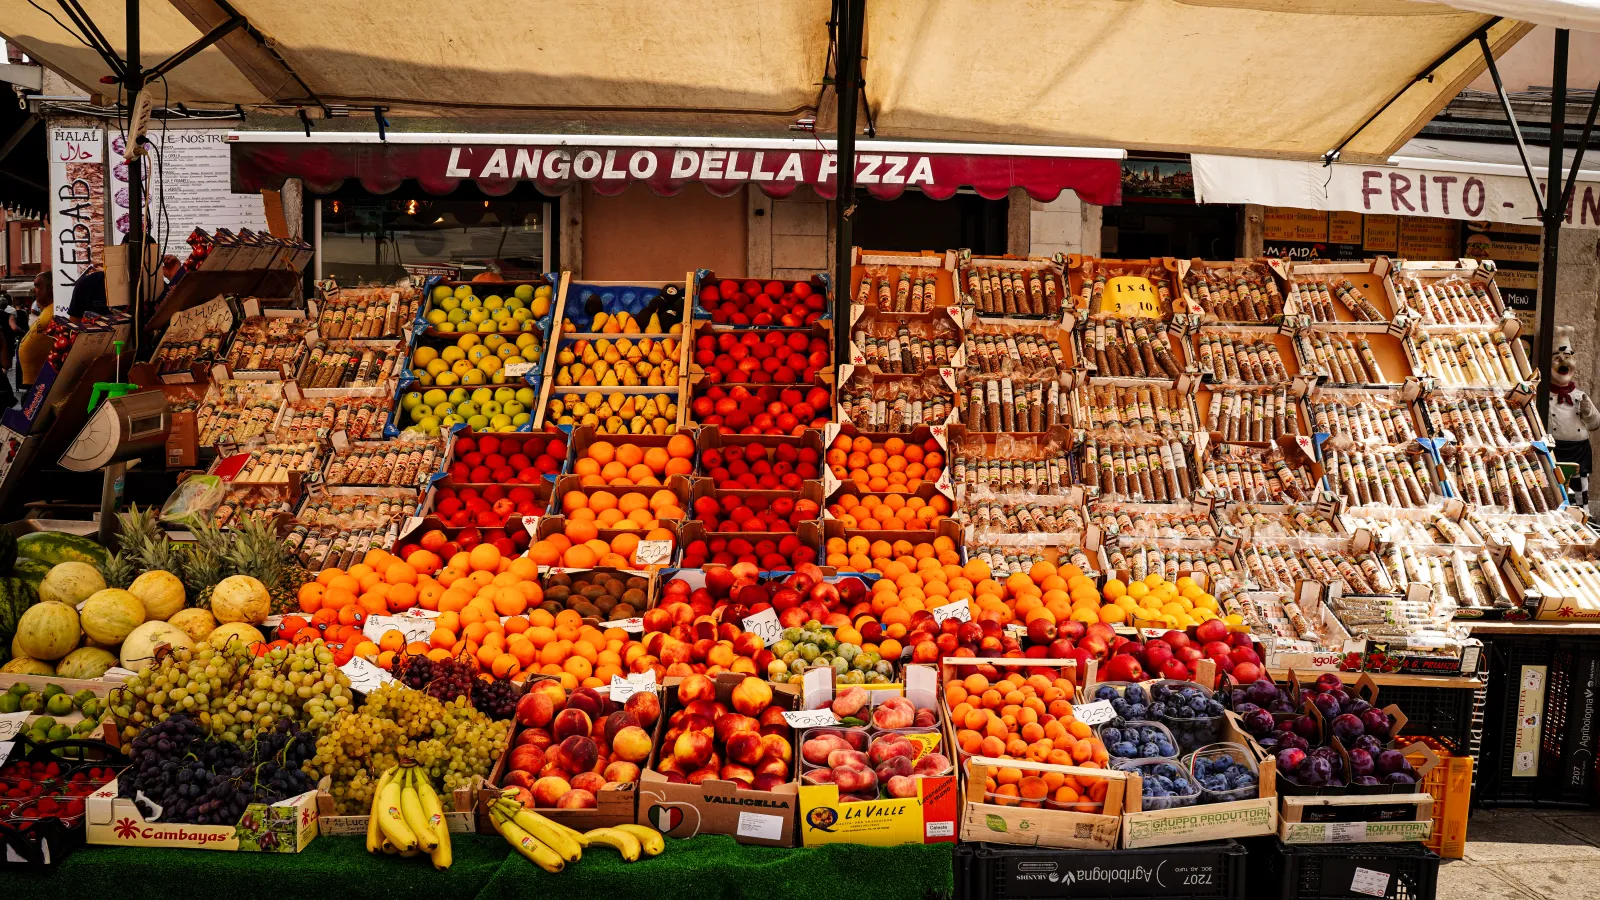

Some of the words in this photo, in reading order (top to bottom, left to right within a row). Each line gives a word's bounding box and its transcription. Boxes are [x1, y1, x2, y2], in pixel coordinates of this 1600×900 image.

[54, 131, 99, 142] HALAL
[60, 141, 93, 161] حلال
[670, 153, 803, 182] DELLA
[818, 154, 935, 186] PZZA
[1362, 170, 1485, 217] FRITO
[59, 178, 94, 288] KEBAB
[1116, 283, 1122, 293] 1
[1138, 283, 1146, 292] 4
[1139, 301, 1153, 312] 10
[1312, 655, 1339, 667] agole
[1423, 661, 1459, 670] PRIMIZIE
[1518, 689, 1527, 717] FRUTTA
[1578, 697, 1595, 747] Agribologna
[1515, 728, 1523, 749] JOLLY
[1571, 765, 1581, 785] 7207
[703, 795, 789, 808] VALLICELLA
[865, 805, 906, 818] VALLE
[1152, 816, 1197, 828] GRUPPO
[1200, 807, 1268, 823] PRODUTTORI
[141, 827, 227, 845] Cambayas
[1366, 824, 1422, 832] RODUTTORI
[1077, 865, 1153, 883] Agribologna
[1183, 873, 1213, 885] 7207
